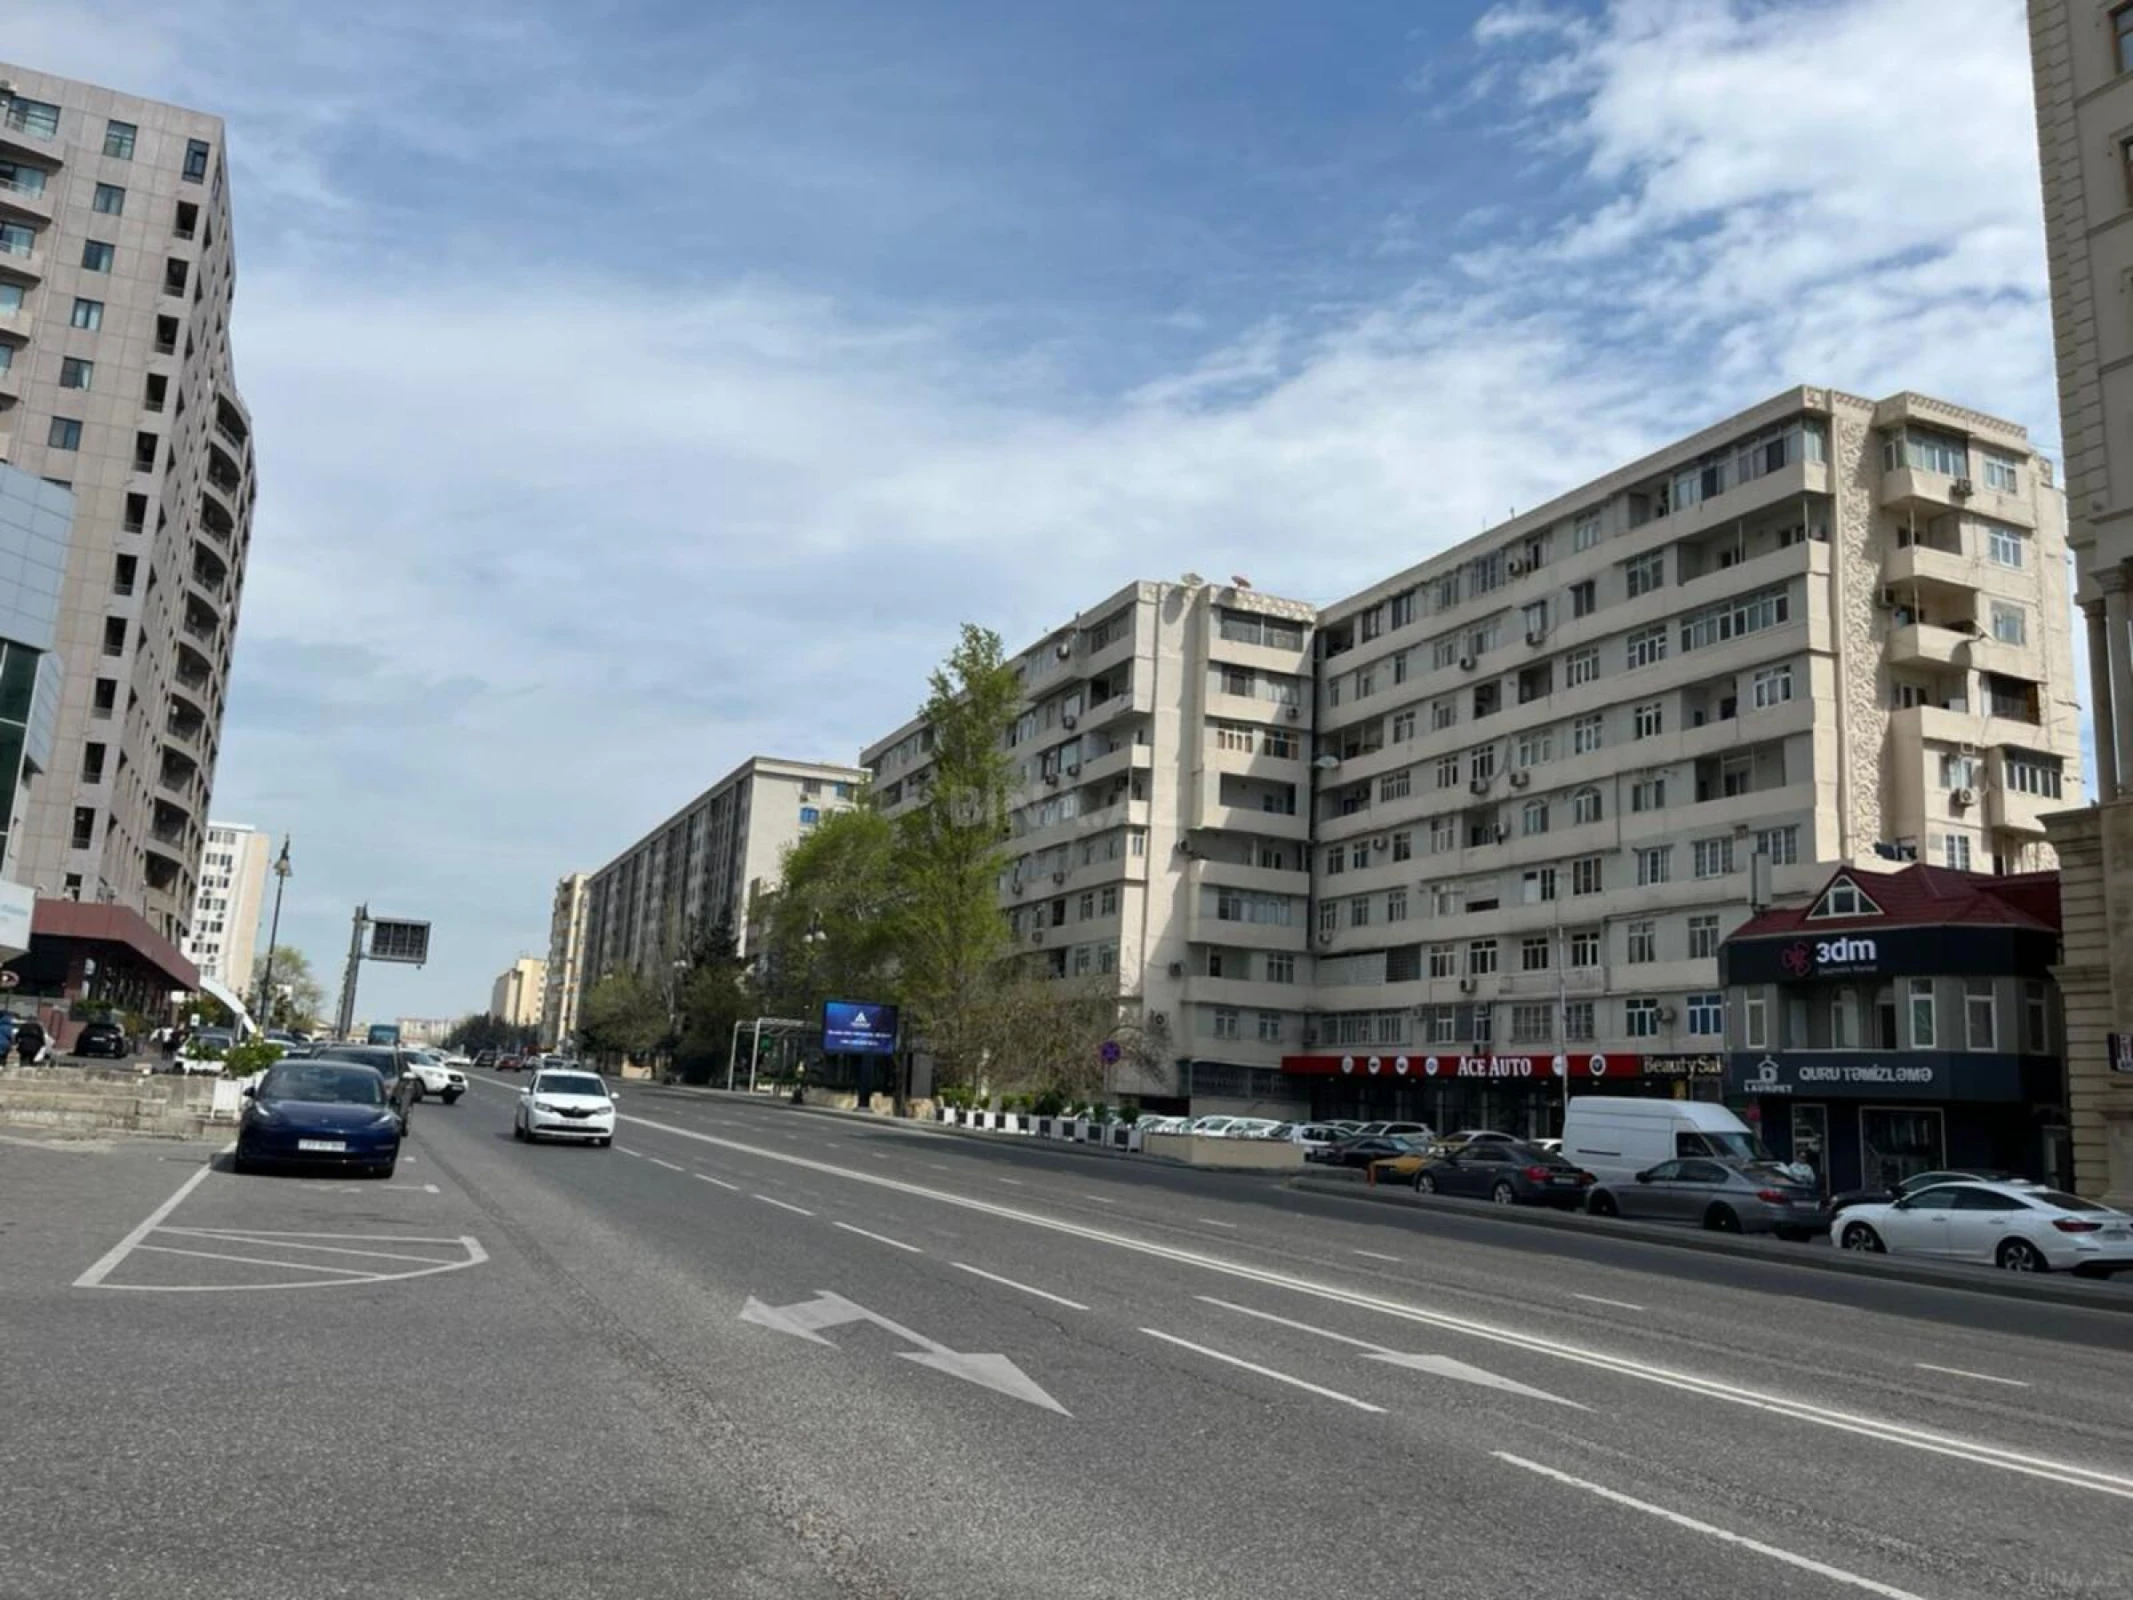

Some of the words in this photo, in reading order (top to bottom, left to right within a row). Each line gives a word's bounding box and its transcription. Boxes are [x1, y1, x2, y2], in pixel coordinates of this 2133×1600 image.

[1816, 936, 1876, 963] 3dm
[1458, 1058, 1486, 1077] ACE
[1488, 1057, 1532, 1077] AUTO
[1799, 1066, 1840, 1081] QURU
